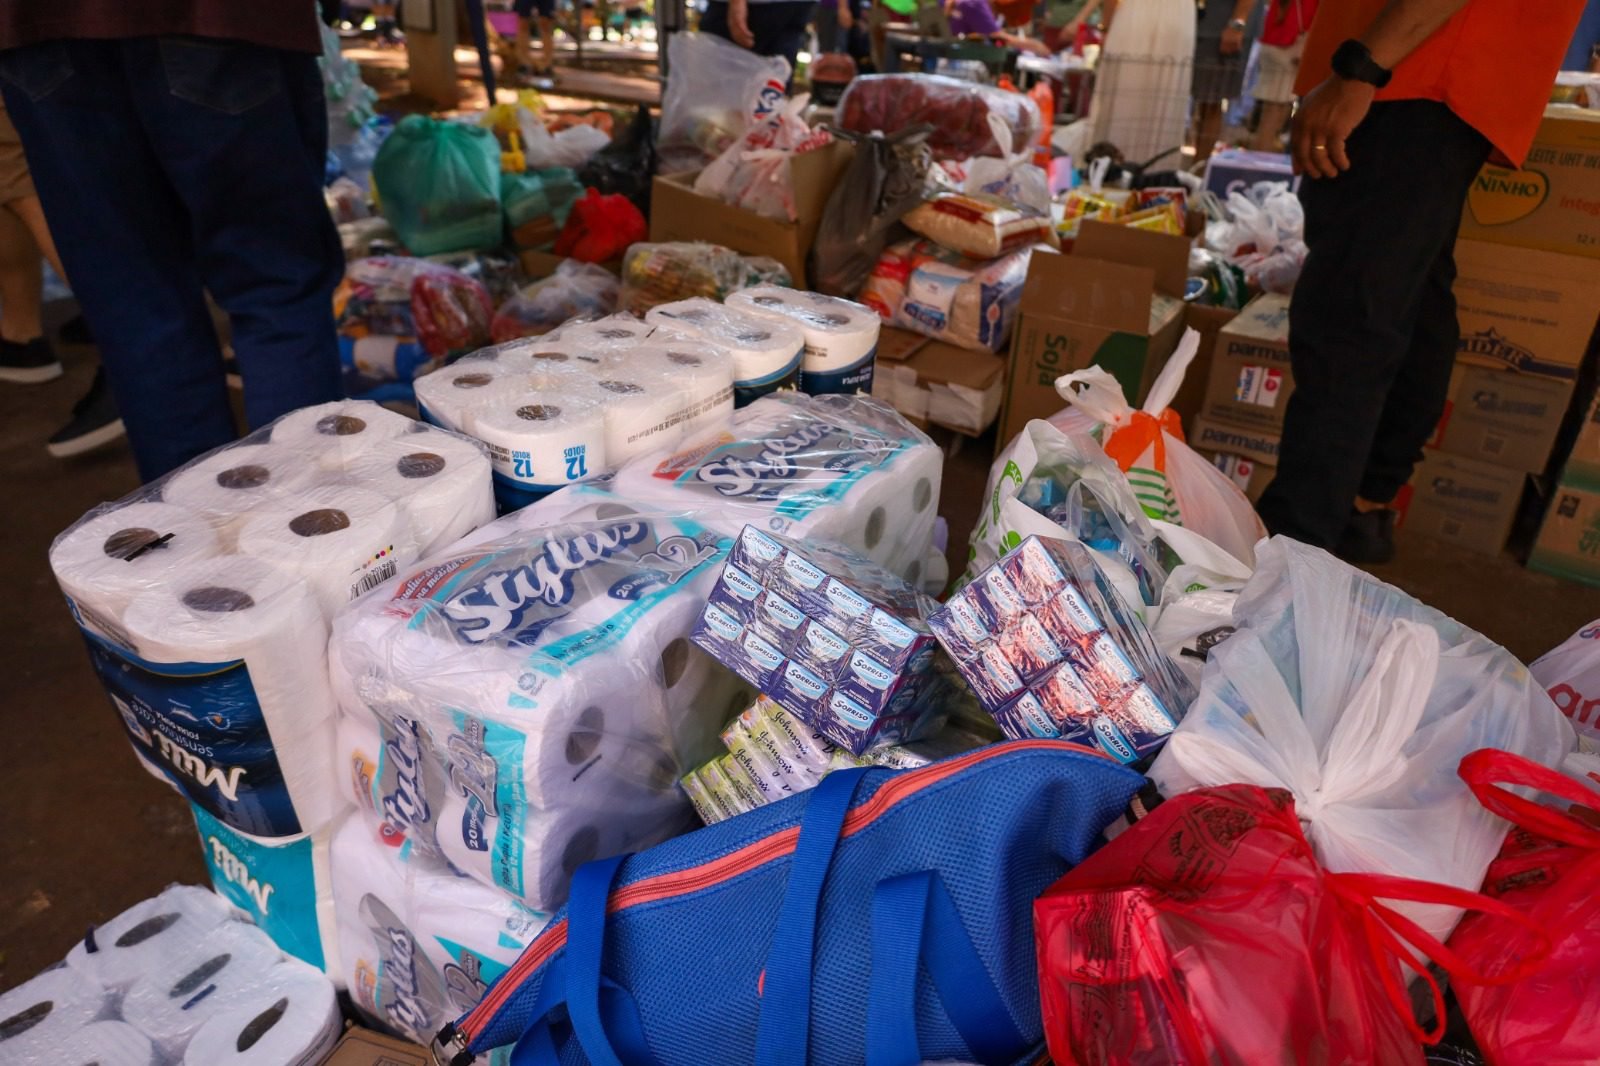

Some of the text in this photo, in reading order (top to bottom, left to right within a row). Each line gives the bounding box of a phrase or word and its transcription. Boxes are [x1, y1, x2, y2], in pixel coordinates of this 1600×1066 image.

[1475, 176, 1540, 197] NINHO
[511, 450, 532, 460] ROLOS
[563, 444, 586, 458] ROLOS
[513, 458, 535, 478] 12
[564, 454, 588, 480] 12
[637, 535, 721, 585] 12
[787, 559, 820, 580] SORRISO
[444, 521, 642, 643] Stylus
[615, 578, 632, 599] 20
[725, 571, 756, 592] SORRISO
[829, 586, 863, 608] SORRISO
[767, 600, 799, 621] SORRISO
[1063, 593, 1093, 625] SORRISO
[707, 611, 737, 633] SORRISO
[809, 628, 842, 650] SORRISO
[747, 640, 779, 662] SORRISO
[788, 668, 821, 691] SORRISO
[853, 658, 889, 681] SORRISO
[132, 701, 156, 725] care
[833, 699, 869, 722] SORRISO
[1021, 700, 1052, 734] SORRISO
[158, 722, 214, 758] sensitive
[772, 711, 809, 756] Johnson's
[1097, 724, 1131, 758] SORRISO
[756, 729, 794, 775] Johnson's
[152, 729, 248, 802] Mili
[735, 747, 770, 793] Johnson's
[469, 831, 479, 849] 20
[208, 835, 275, 916] Mili
[383, 927, 432, 1036] tylus
